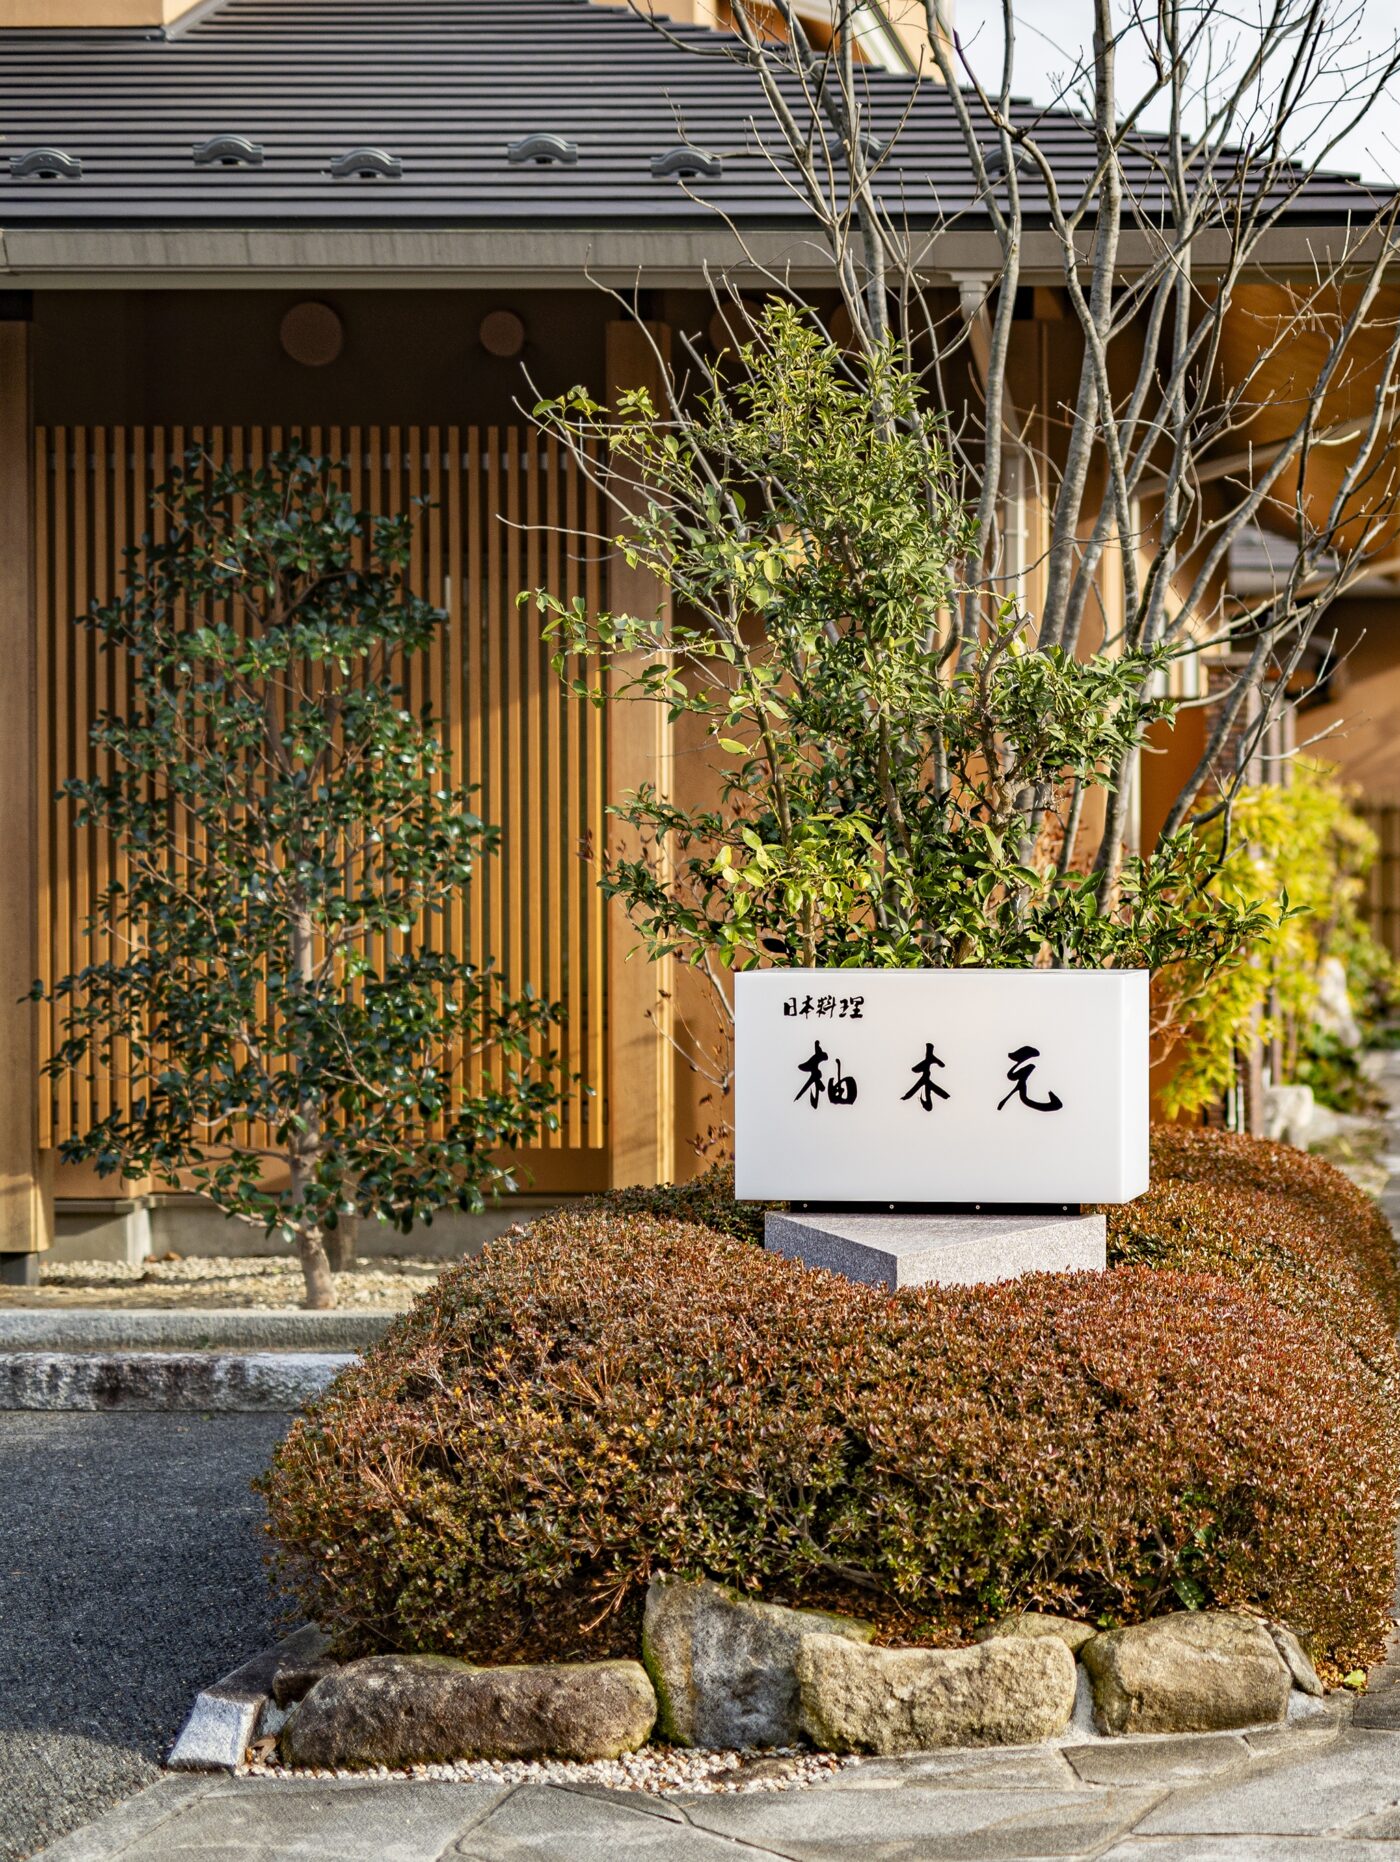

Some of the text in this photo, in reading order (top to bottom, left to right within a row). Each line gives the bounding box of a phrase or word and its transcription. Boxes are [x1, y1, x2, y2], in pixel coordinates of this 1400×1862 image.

[783, 995, 865, 1019] 日本料理
[794, 1040, 1063, 1112] 柚木元
